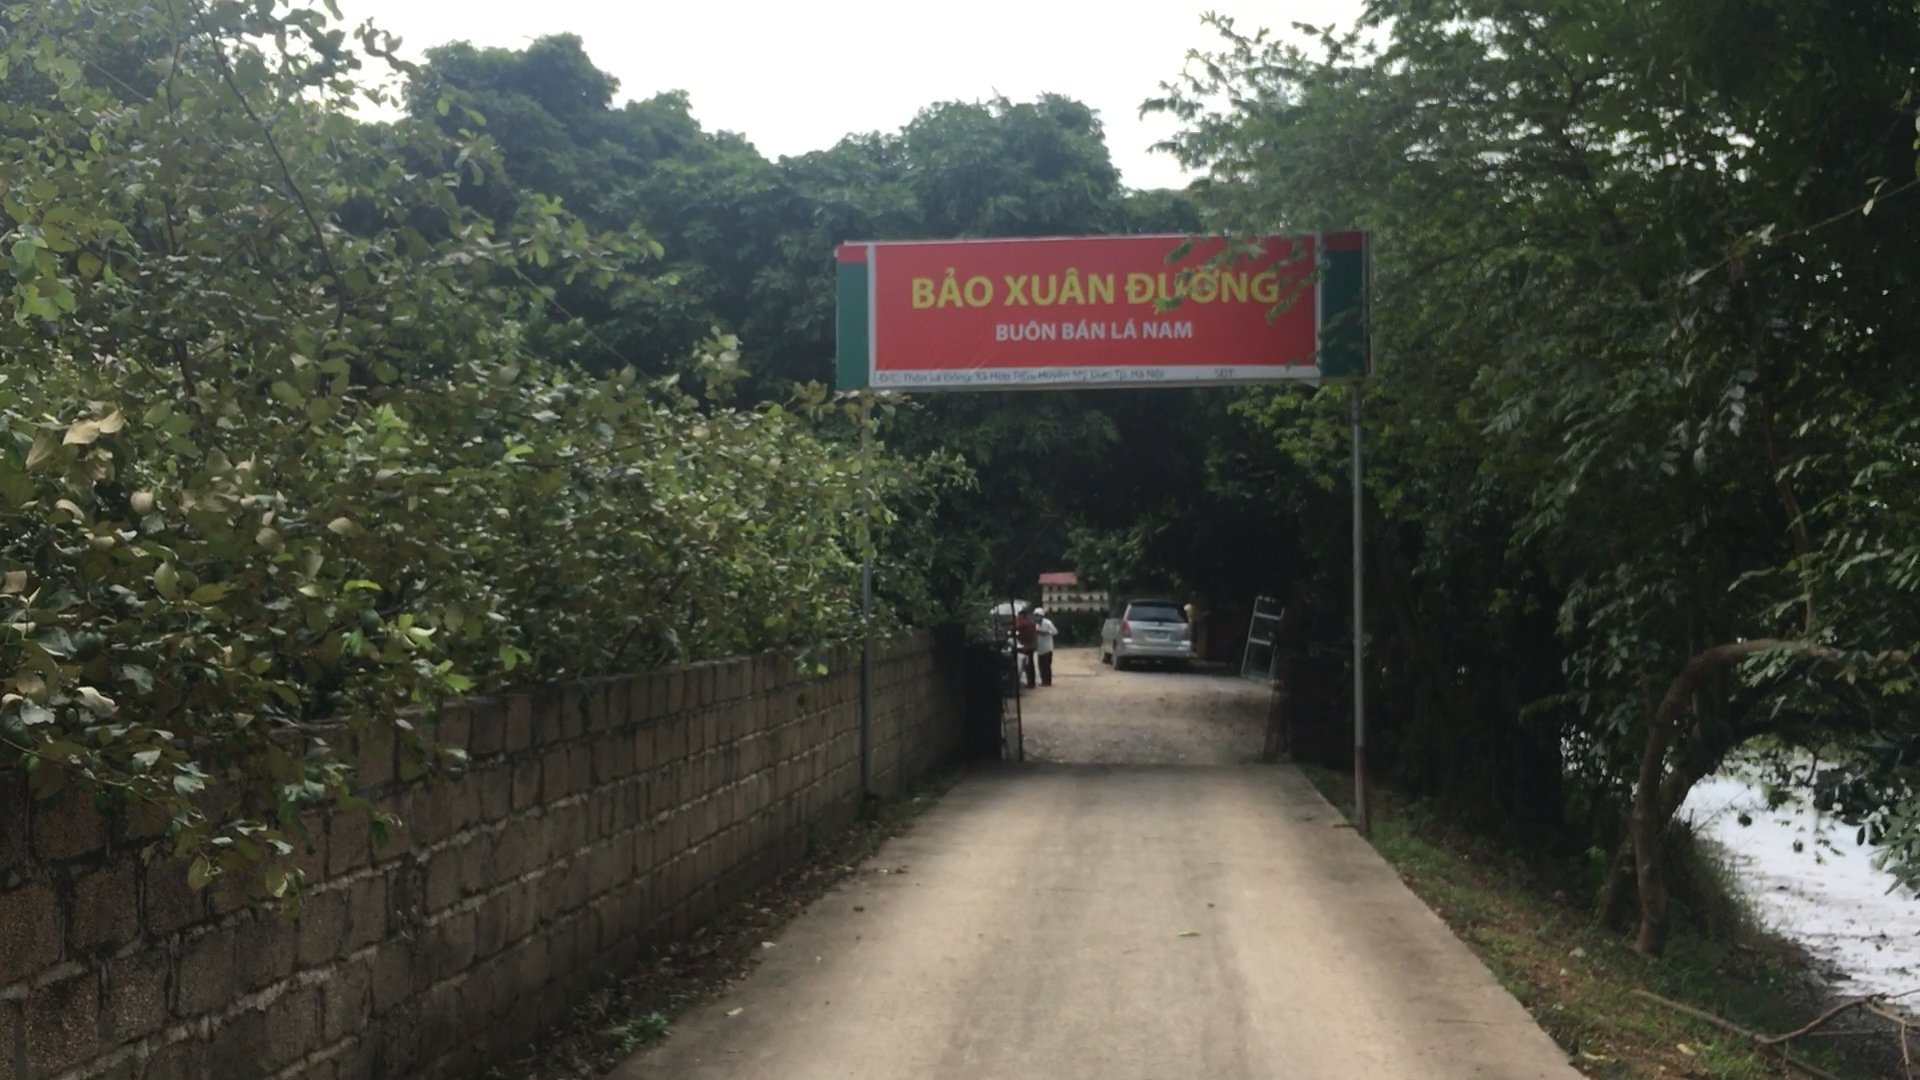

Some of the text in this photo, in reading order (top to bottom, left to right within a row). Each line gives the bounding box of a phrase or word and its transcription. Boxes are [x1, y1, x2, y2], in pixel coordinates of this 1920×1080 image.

[911, 267, 994, 309] BẢO
[1003, 267, 1115, 306] XUÂN
[995, 318, 1193, 342] BUÔN BÁN LÁ NAM
